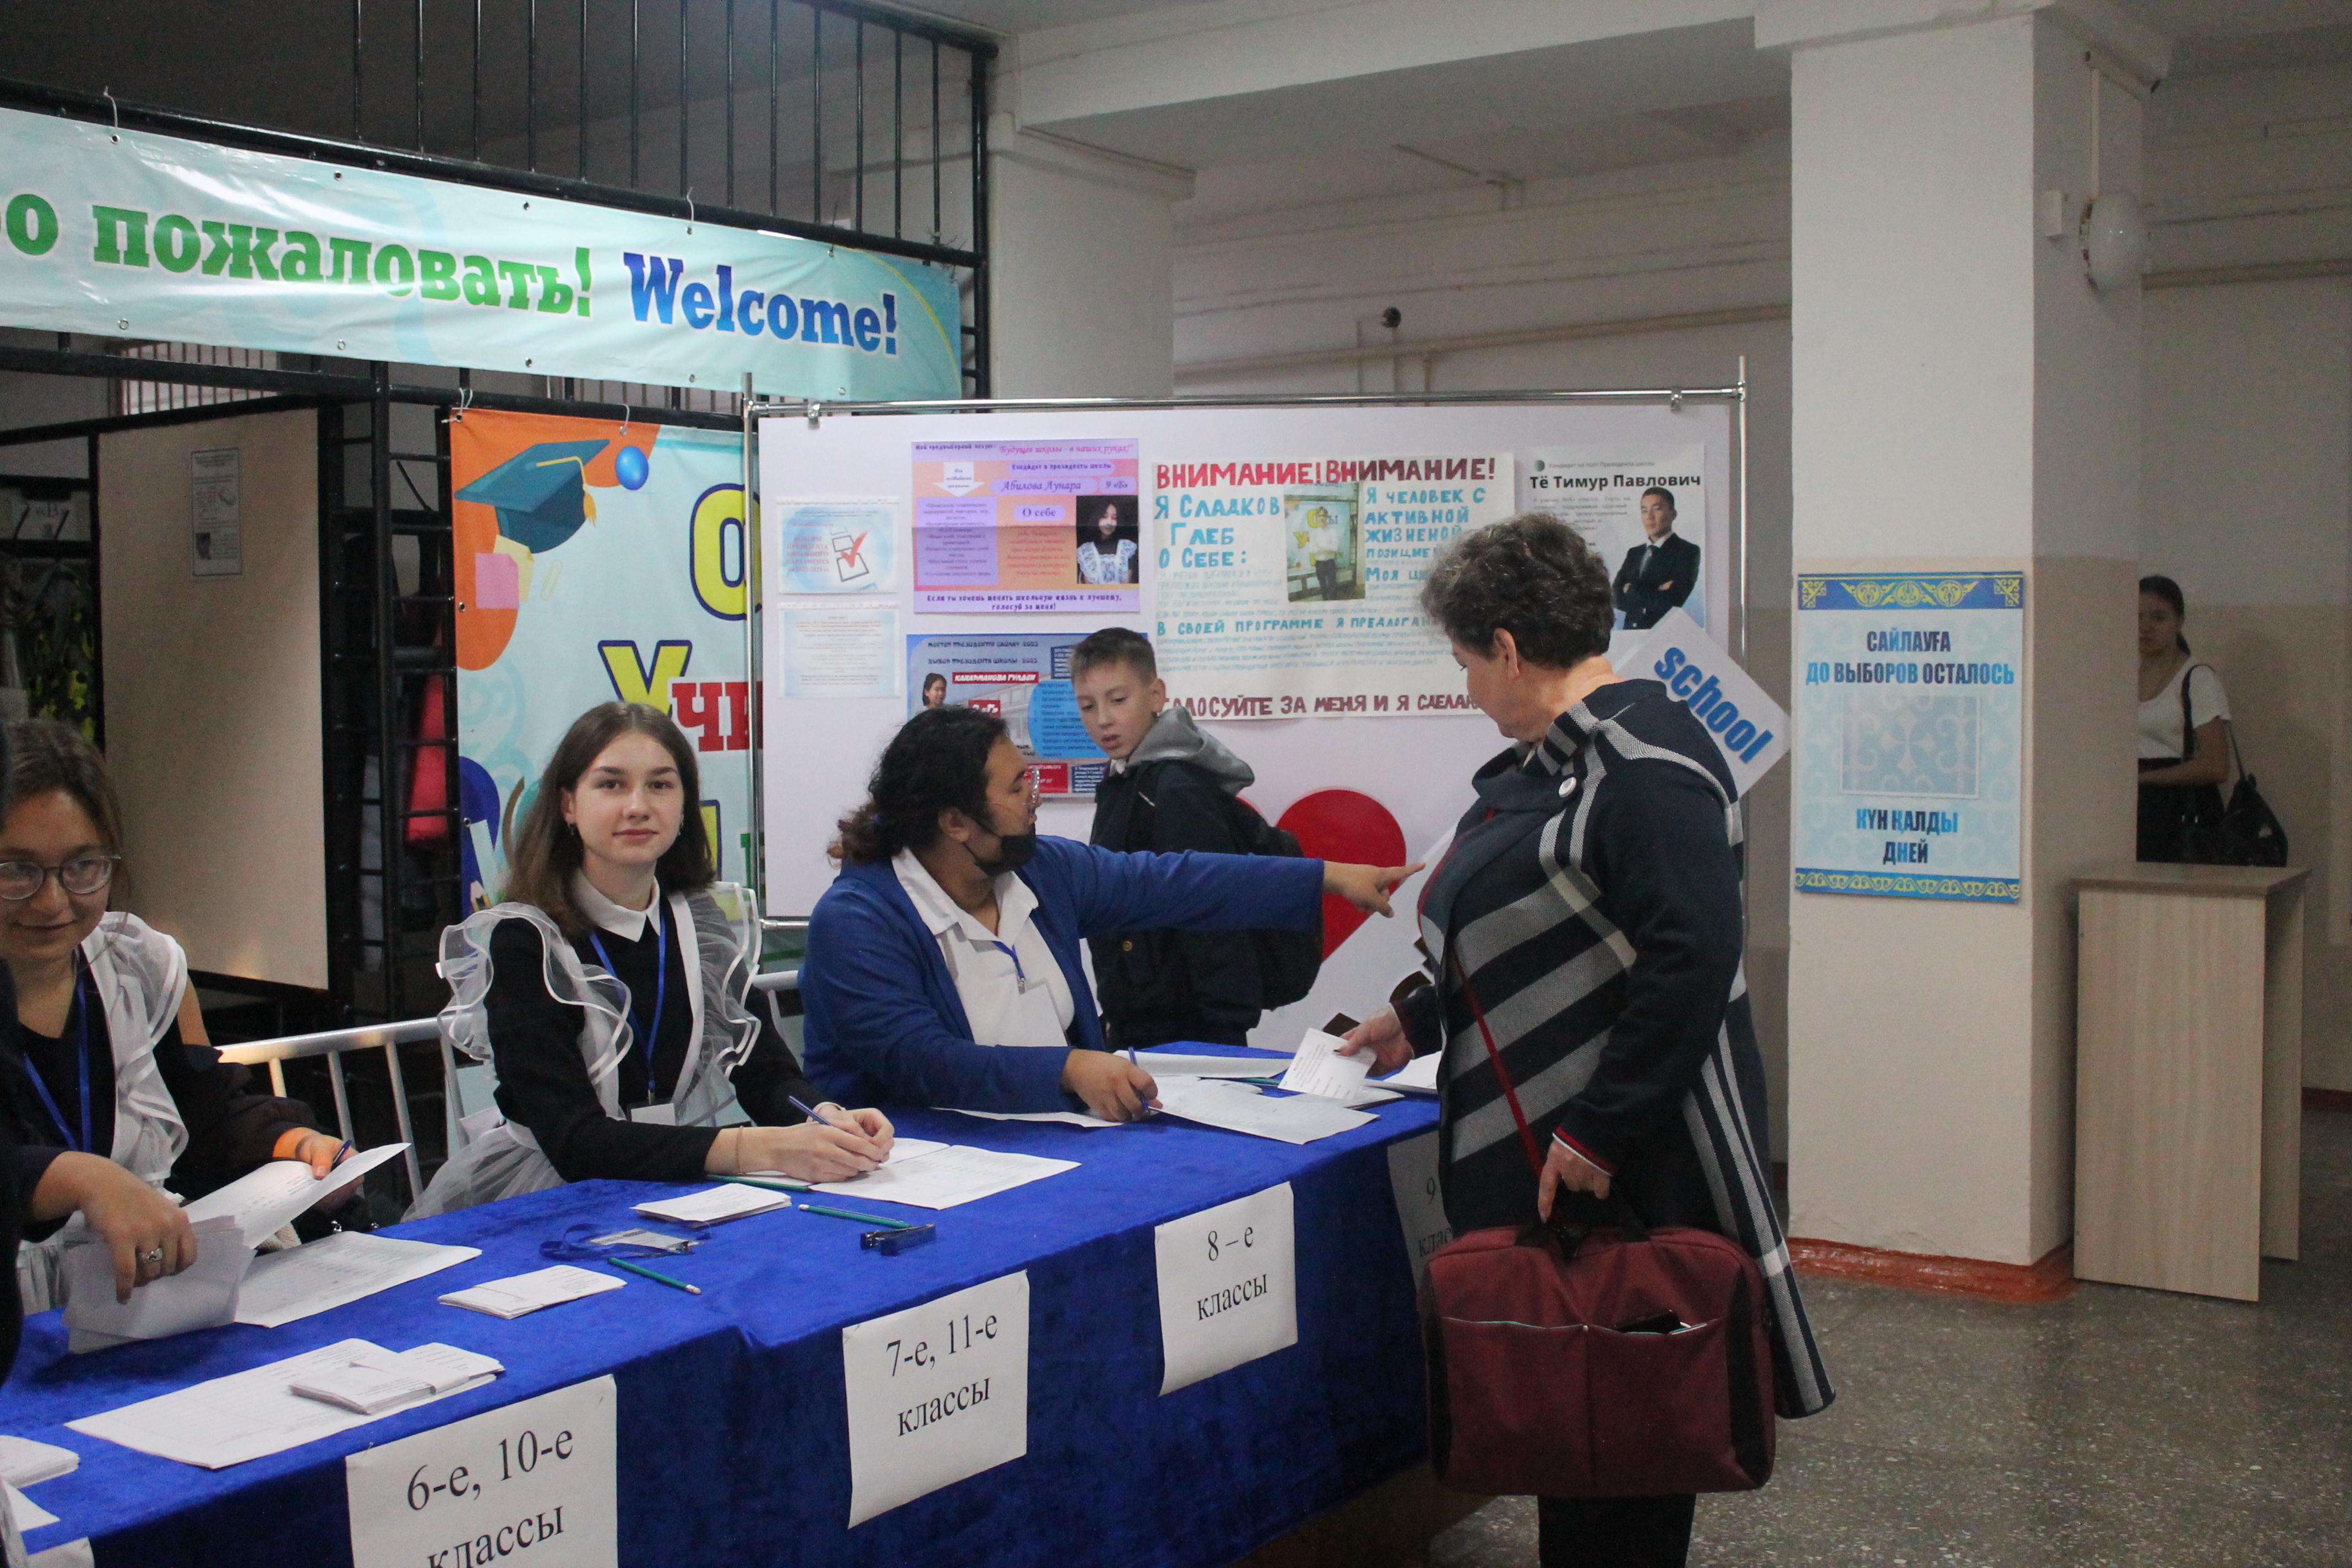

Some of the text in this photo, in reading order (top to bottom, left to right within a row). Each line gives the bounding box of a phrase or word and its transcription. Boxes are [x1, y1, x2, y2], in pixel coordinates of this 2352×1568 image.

[92, 204, 591, 317] пожаловать!
[623, 252, 896, 355] Welcome!
[1157, 458, 1495, 489] ВНИМАНИЕ! ВНИМАНИЕ!
[1530, 475, 1701, 492] Тё Тимур Павлович
[1154, 495, 1169, 519] Я
[1366, 487, 1487, 505] Я ЧЕЛОВЕК С
[1022, 507, 1057, 517] О себе
[1365, 506, 1469, 525] АКТИВНОЙ
[1157, 621, 1166, 636] В
[1178, 619, 1225, 635] СВОЕЙ
[1235, 618, 1324, 633] ПРОГРАММЕ
[1336, 617, 1344, 628] Я
[1806, 662, 2015, 685] ДО ВЫБОРОВ ОСТАЛОСЬ
[1280, 695, 1307, 714] ЗА
[1314, 694, 1367, 713] МЕНЯ
[1374, 695, 1388, 711] И
[1396, 694, 1409, 711] Я
[1654, 647, 1774, 764] school
[1882, 838, 1929, 865] ДНЕЙ
[1207, 1231, 1219, 1261] 8
[1196, 1273, 1267, 1321] классы
[886, 1314, 998, 1377] 7-е, 11-е
[897, 1378, 990, 1437] классы
[407, 1430, 573, 1511] 6-е, 10-е
[427, 1506, 565, 1568] классы
